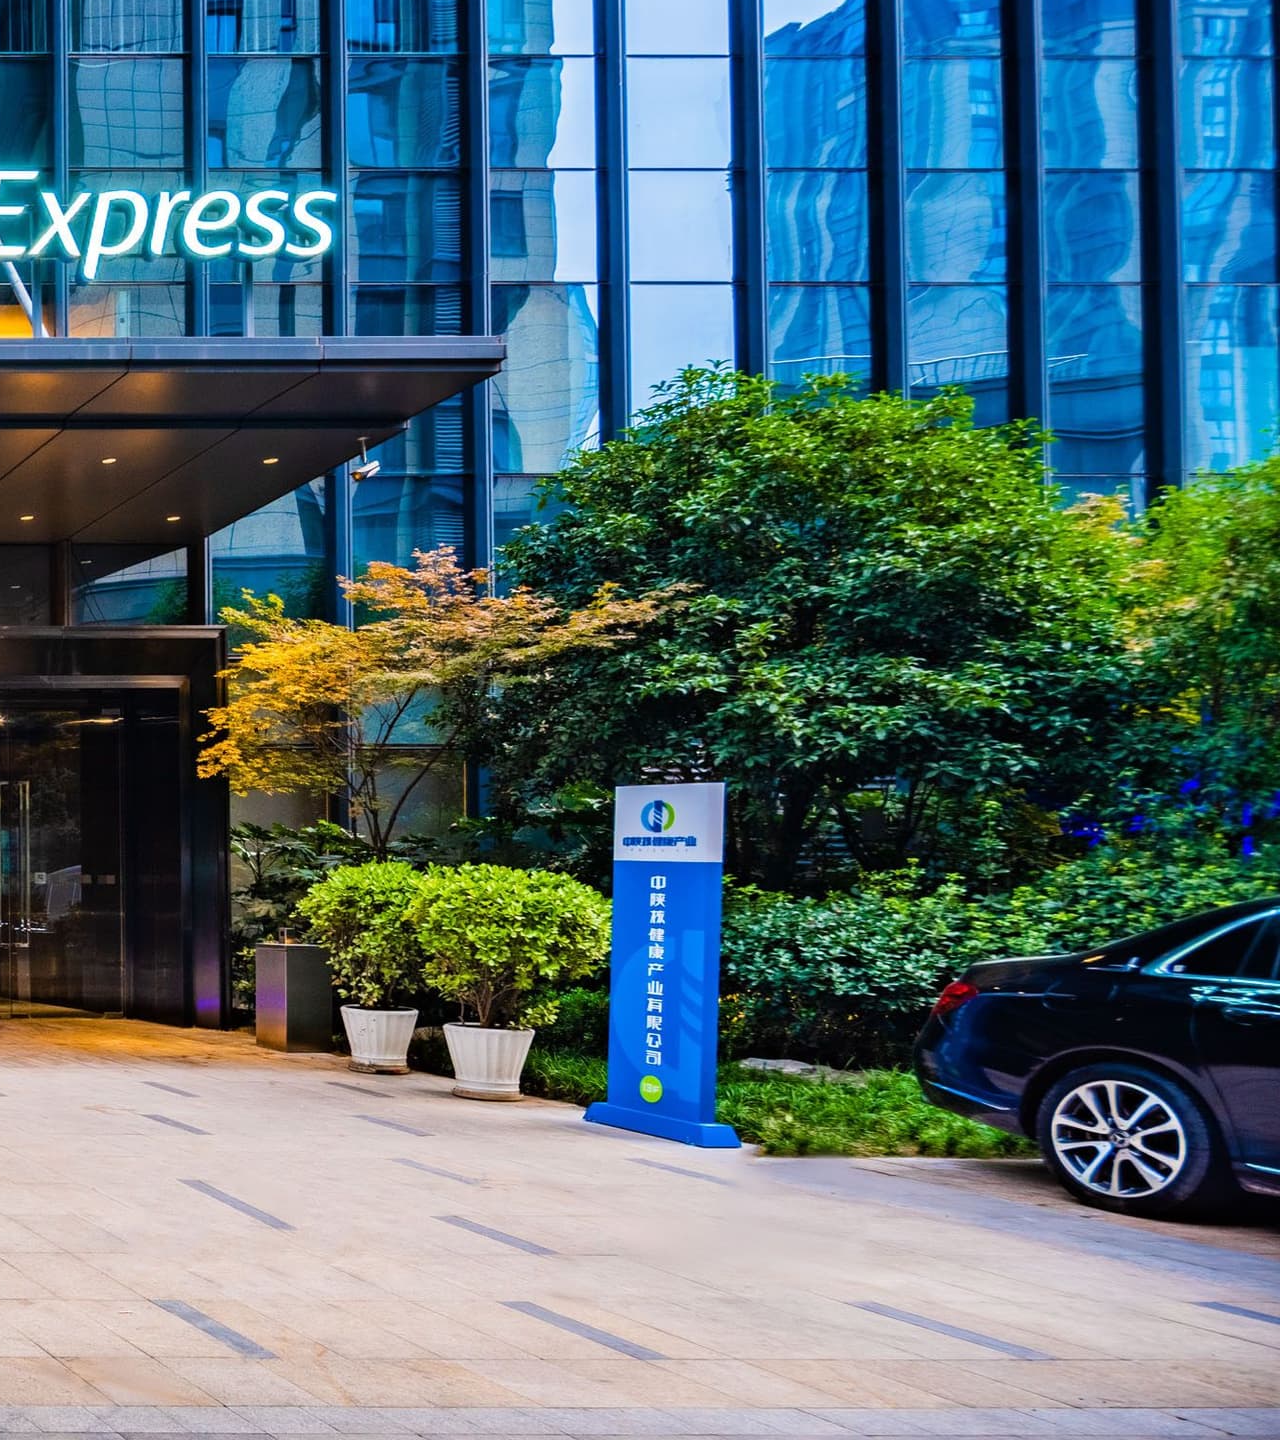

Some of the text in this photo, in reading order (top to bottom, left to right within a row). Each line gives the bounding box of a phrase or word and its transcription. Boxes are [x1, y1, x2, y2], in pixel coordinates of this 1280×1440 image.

[645, 874, 667, 1067] 中陕核健康产业有限公司
